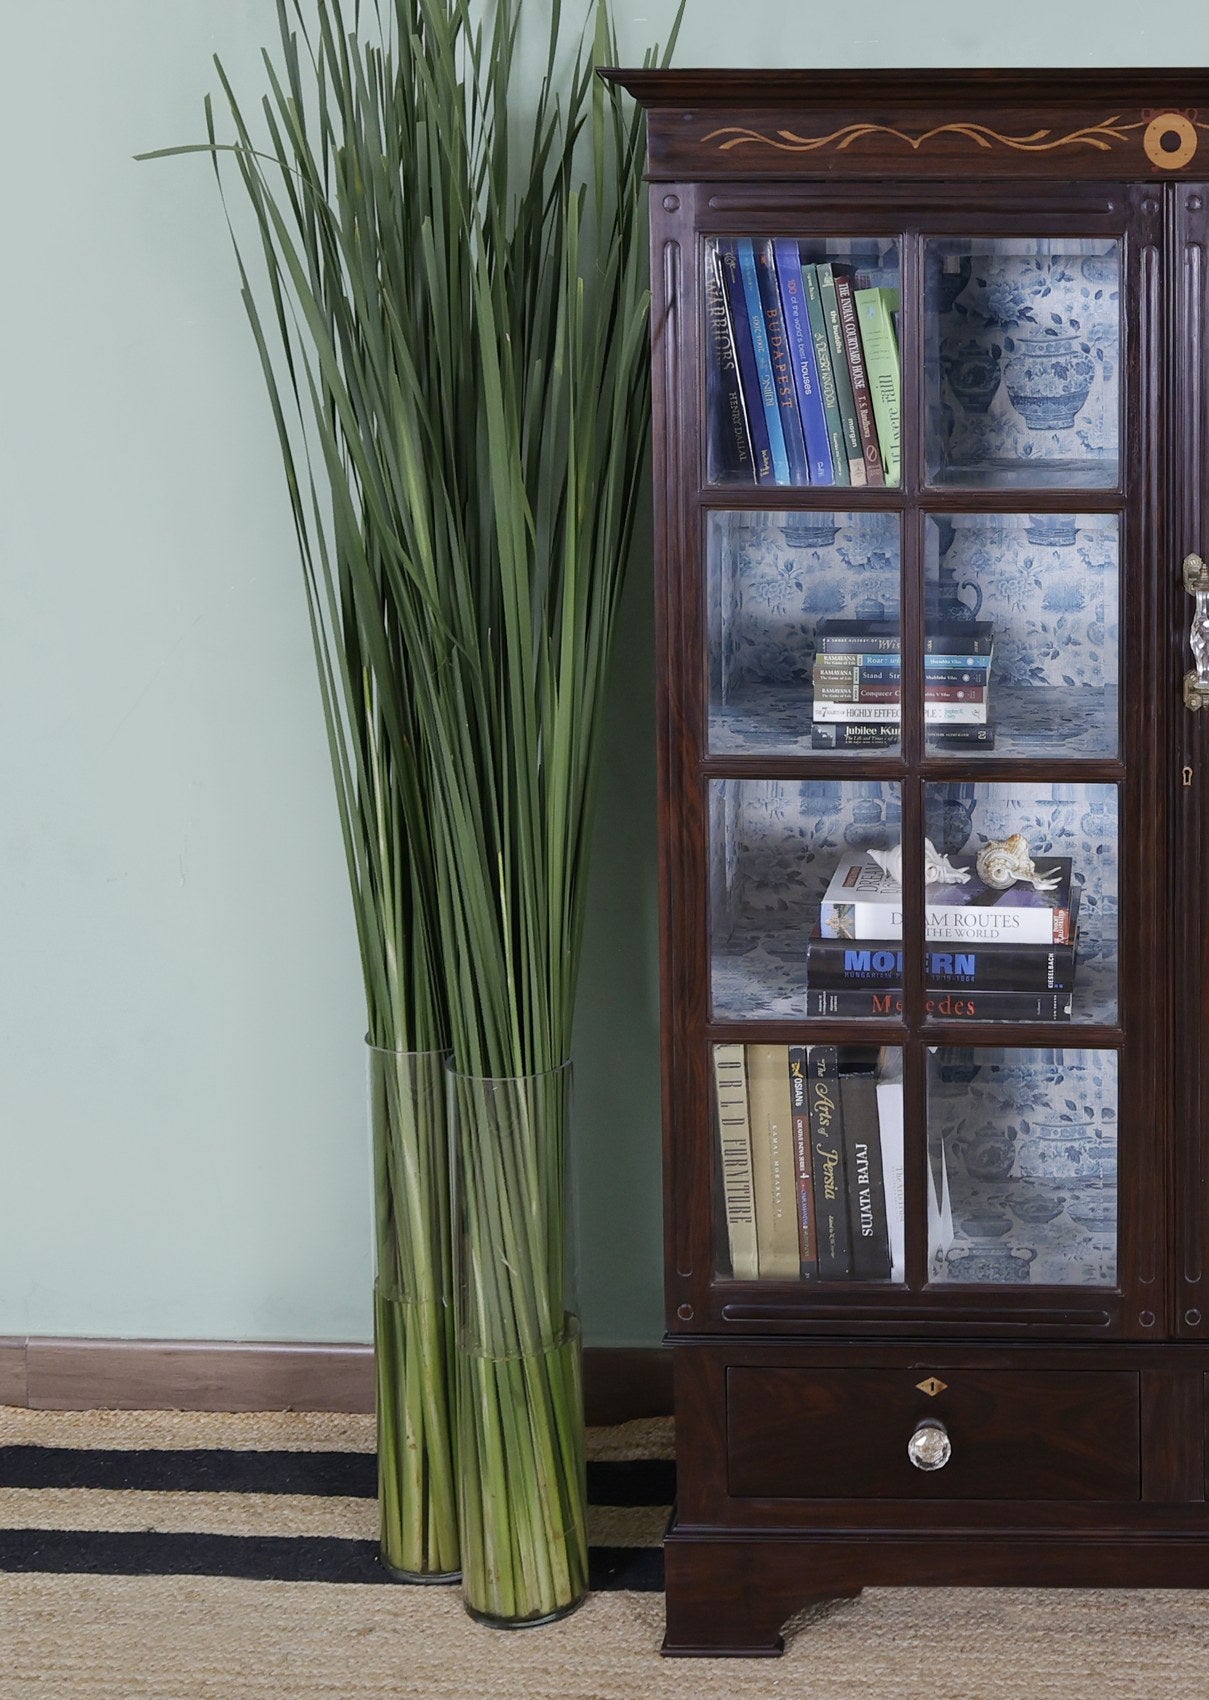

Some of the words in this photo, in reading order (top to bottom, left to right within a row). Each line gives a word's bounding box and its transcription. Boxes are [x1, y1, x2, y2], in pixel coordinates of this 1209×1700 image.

[791, 296, 800, 305] of
[838, 282, 851, 298] THE
[793, 305, 802, 317] the
[830, 310, 839, 324] the
[840, 298, 857, 322] INDIAN
[794, 317, 806, 343] world's
[832, 325, 843, 354] buddha
[843, 322, 863, 365] COURTYARD
[765, 308, 793, 409] BUDAPEST
[798, 344, 808, 359] best
[800, 361, 813, 396] houses
[851, 364, 866, 390] HOUSE
[729, 391, 742, 426] HENRY
[886, 408, 900, 438] were
[733, 426, 748, 463] DALLAL
[847, 418, 858, 448] morgan
[867, 656, 882, 664] Roar
[821, 706, 827, 718] 7
[844, 725, 877, 736] Jubilee
[954, 912, 1020, 929] ROUTES
[954, 928, 1000, 939] WORLD
[1047, 952, 1055, 989] KIESELBACH
[813, 1082, 835, 1127] Arts
[816, 1143, 839, 1200] Persia
[854, 1143, 871, 1185] BAJAJ
[723, 1139, 752, 1224] FURNITURE
[858, 1187, 873, 1237] SUJATA
